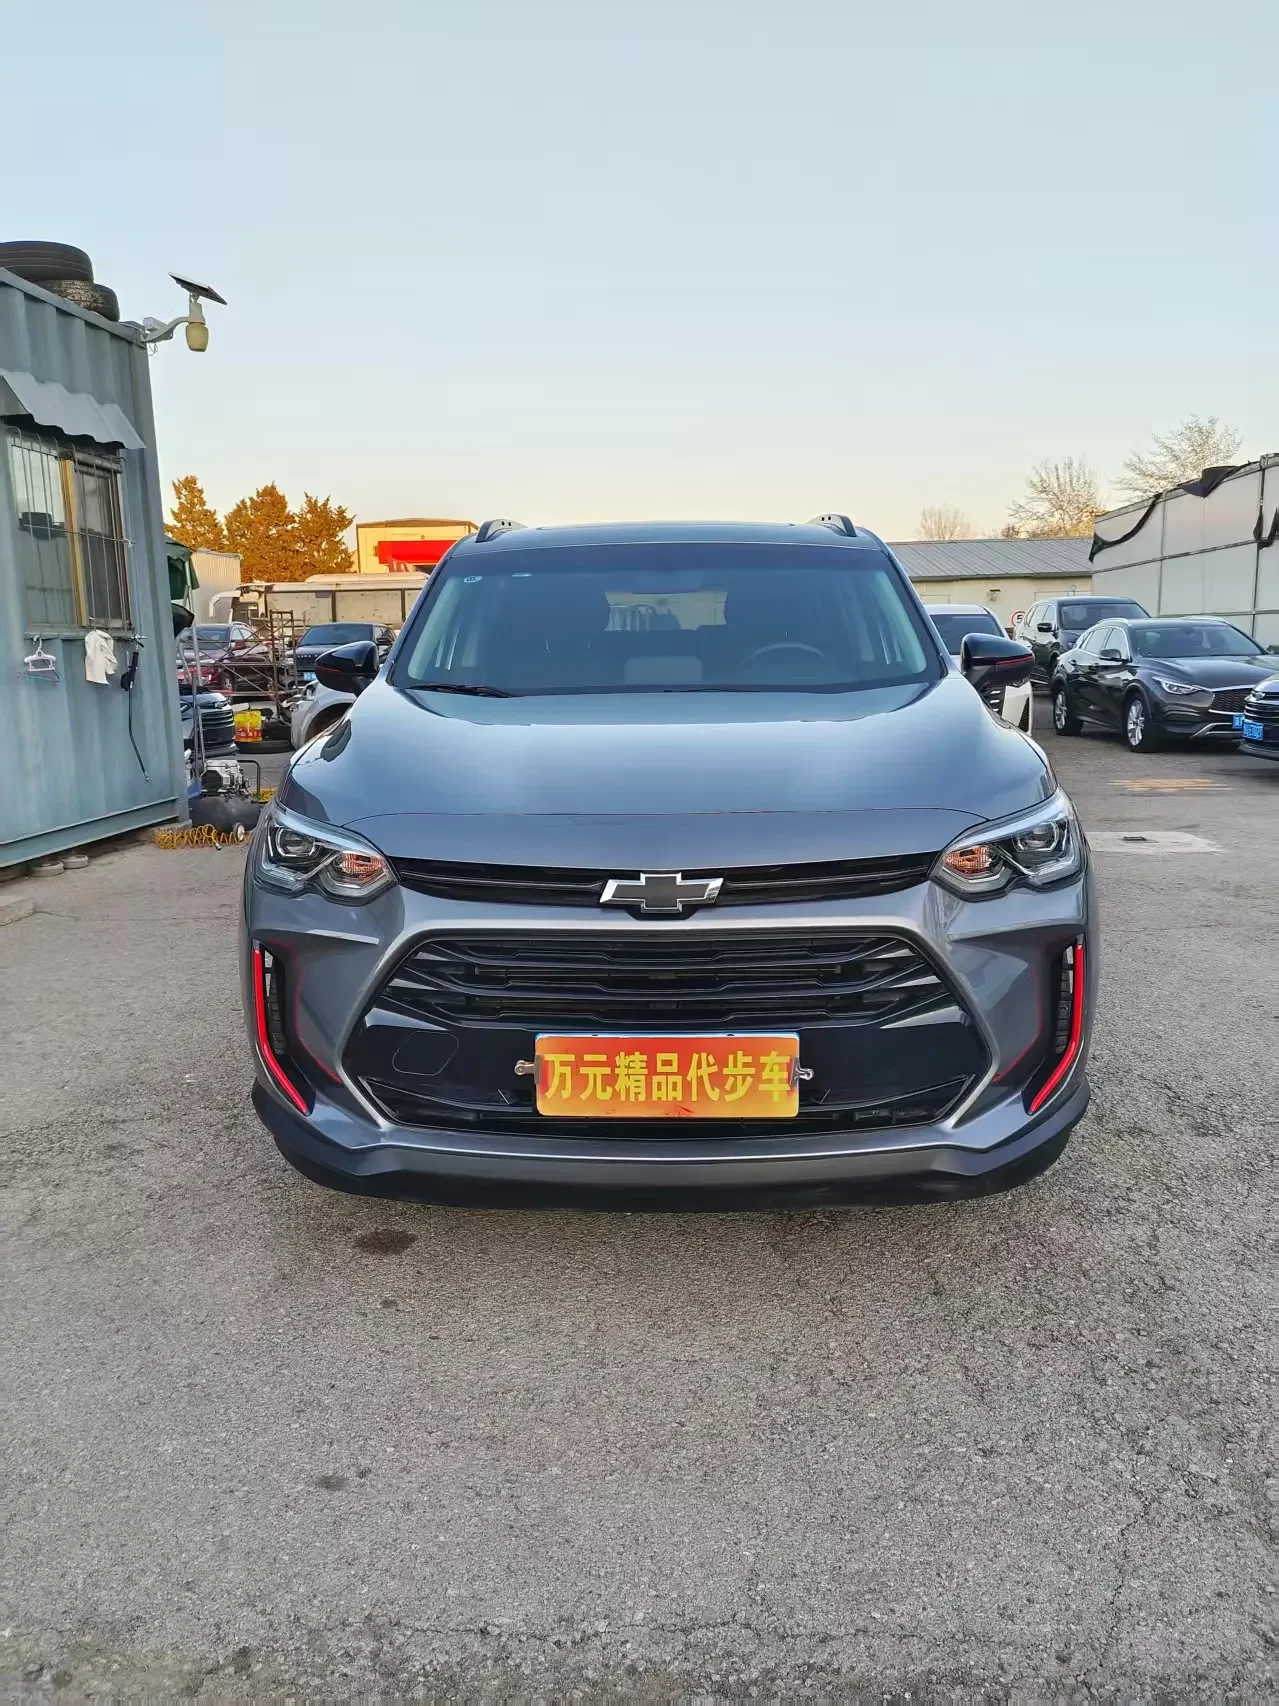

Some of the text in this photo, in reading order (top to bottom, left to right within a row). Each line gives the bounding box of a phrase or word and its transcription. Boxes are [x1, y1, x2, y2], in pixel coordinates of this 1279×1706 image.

[544, 1051, 791, 1102] 万元精品代步车
